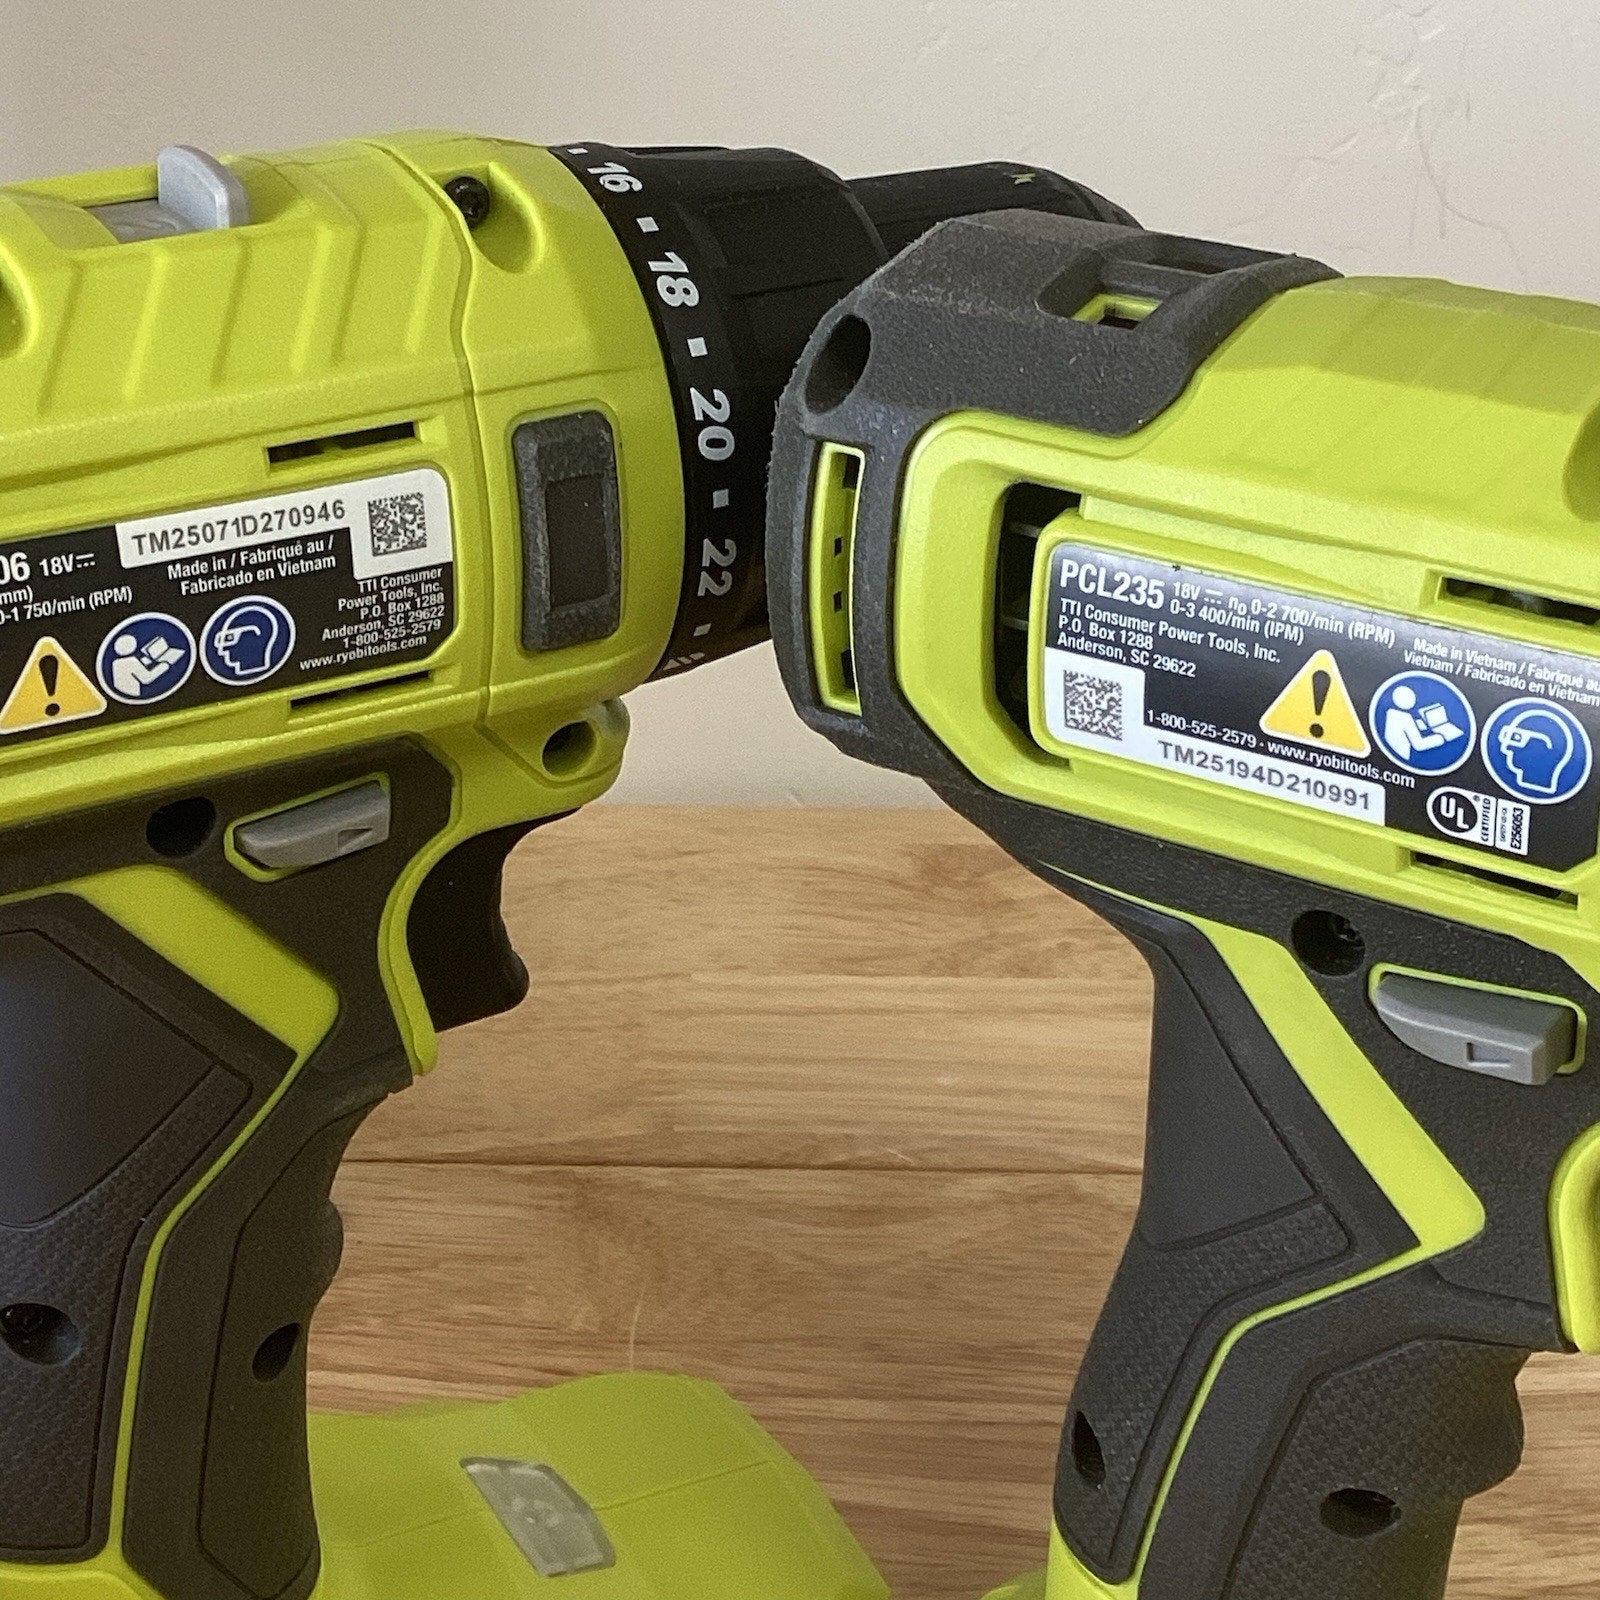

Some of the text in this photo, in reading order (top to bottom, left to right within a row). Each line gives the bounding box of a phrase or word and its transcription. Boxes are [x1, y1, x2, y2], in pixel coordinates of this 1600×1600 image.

[586, 161, 643, 193] 16
[647, 251, 700, 308] 18
[690, 386, 735, 461] 20
[131, 499, 345, 556] TM25071D270946
[39, 553, 74, 577] 18V
[167, 559, 208, 580] Made
[212, 556, 227, 572] in
[240, 541, 303, 567] Fabriqué
[306, 539, 325, 552] au
[181, 555, 336, 596] Fabricado en Vietnam
[357, 568, 443, 594] TTI Consumer
[697, 538, 737, 597] 22
[23, 595, 86, 620] 750/min
[89, 585, 133, 610] (RPM)
[337, 581, 444, 612] Power Tools, Inc.
[1060, 558, 1166, 609] PCL235
[321, 605, 445, 642] Anderson, SC 29622
[360, 592, 445, 620] P.O. Box 1288
[1169, 598, 1305, 646] 0-3 400/min (IPM)
[1173, 581, 1201, 601] 18V
[1251, 598, 1277, 619] 0-2
[1281, 605, 1344, 634] 700/min
[1348, 620, 1396, 649] (RPM)
[342, 618, 441, 649] 1-800-525-2579
[1058, 614, 1154, 650] P.O. Box 1288
[1060, 597, 1281, 663] TTI Consumer Power Tools, Inc.
[299, 635, 427, 671] www.ryobitools.com
[1057, 631, 1197, 678] Anderson, SC 29622
[1413, 637, 1448, 658] Made
[1450, 645, 1462, 661] in
[1465, 649, 1517, 674] Vietnam
[1527, 663, 1584, 689] Fabriqué
[1404, 650, 1454, 675] Vietnam
[1464, 664, 1527, 690] Fabricado
[1529, 682, 1545, 695] en
[1547, 683, 1600, 707] Vietnam
[1147, 709, 1257, 749] 1-800-525-2579
[1267, 740, 1416, 789] www.ryobitools.com
[1158, 739, 1370, 811] TM25194D210991
[1440, 795, 1470, 830] UL
[1480, 798, 1491, 842] CERTIFIED
